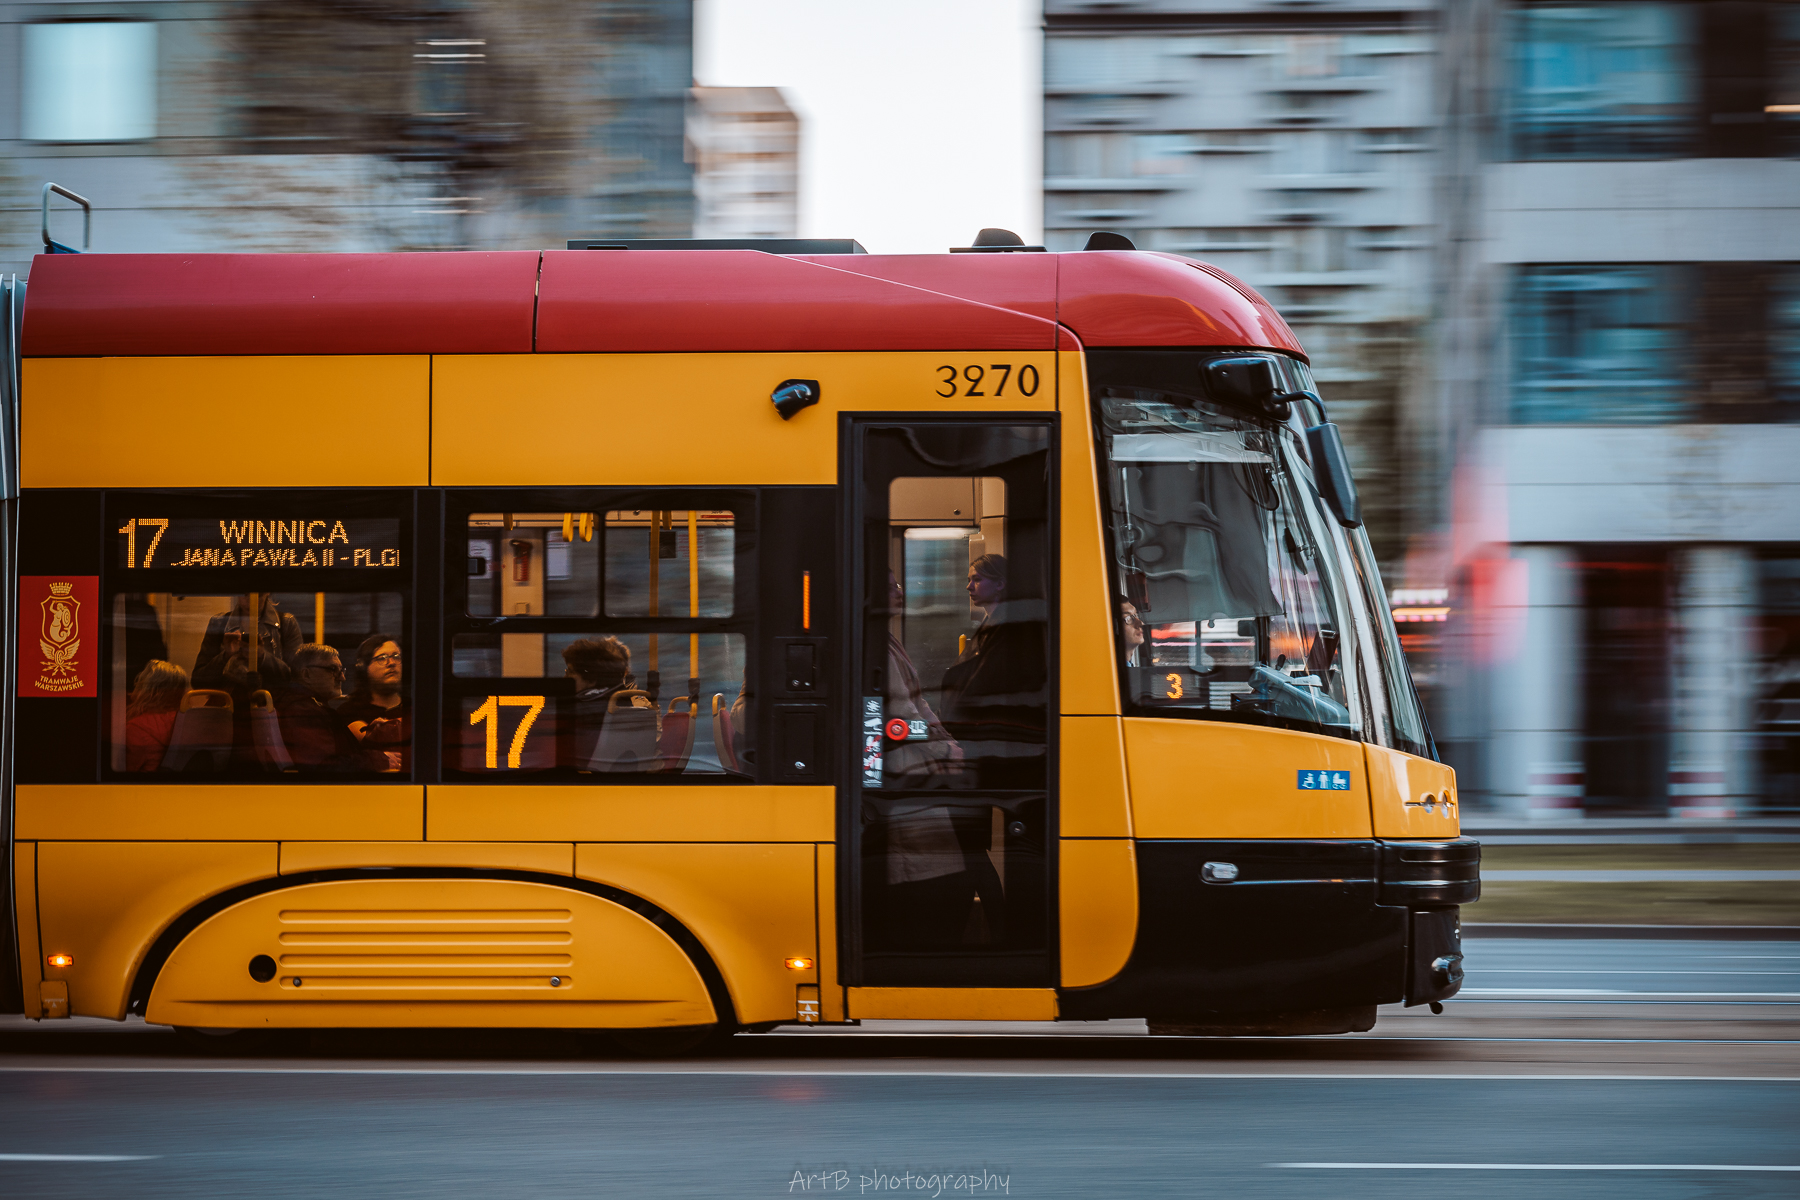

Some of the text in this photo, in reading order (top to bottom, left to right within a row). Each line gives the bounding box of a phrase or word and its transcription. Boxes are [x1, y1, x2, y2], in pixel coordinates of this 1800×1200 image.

[935, 364, 1040, 398] 3270
[118, 518, 169, 568] 17
[219, 520, 349, 544] WINNICA
[240, 548, 319, 567] PAWŁA
[34, 680, 84, 692] WARSZAWSKIE
[40, 675, 79, 685] TRAMWAJE
[1166, 673, 1183, 699] 3
[470, 695, 545, 769] 17
